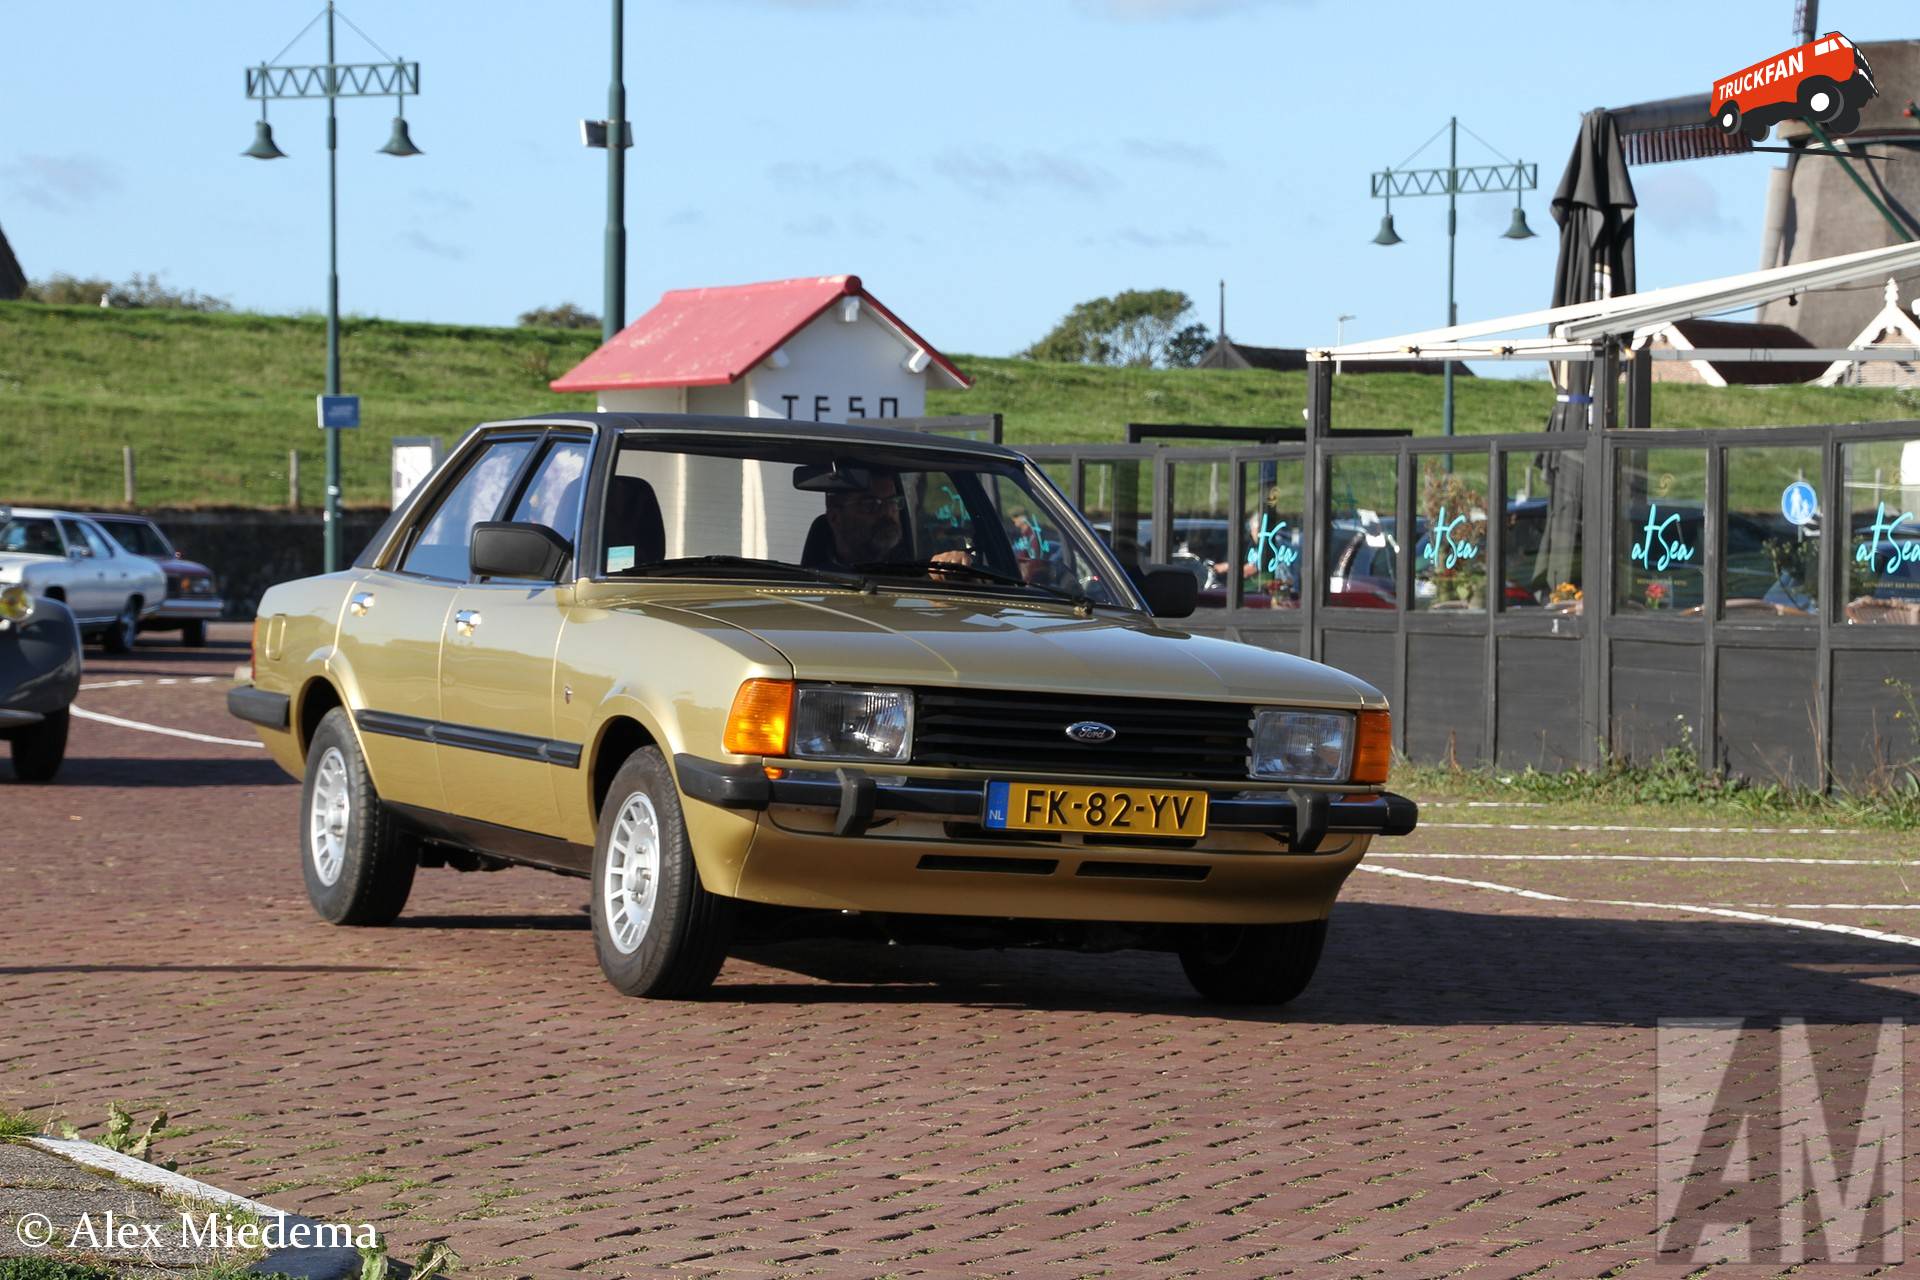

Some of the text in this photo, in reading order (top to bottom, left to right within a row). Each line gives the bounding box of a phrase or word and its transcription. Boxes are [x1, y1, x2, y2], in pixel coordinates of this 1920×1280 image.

[1267, 520, 1299, 573] Sea
[1446, 514, 1479, 570] Sea
[1631, 503, 1695, 572] at Sea
[1855, 501, 1888, 573] at
[1078, 725, 1107, 738] Ford
[988, 809, 1005, 821] NL
[1023, 788, 1195, 830] FK-82-YV
